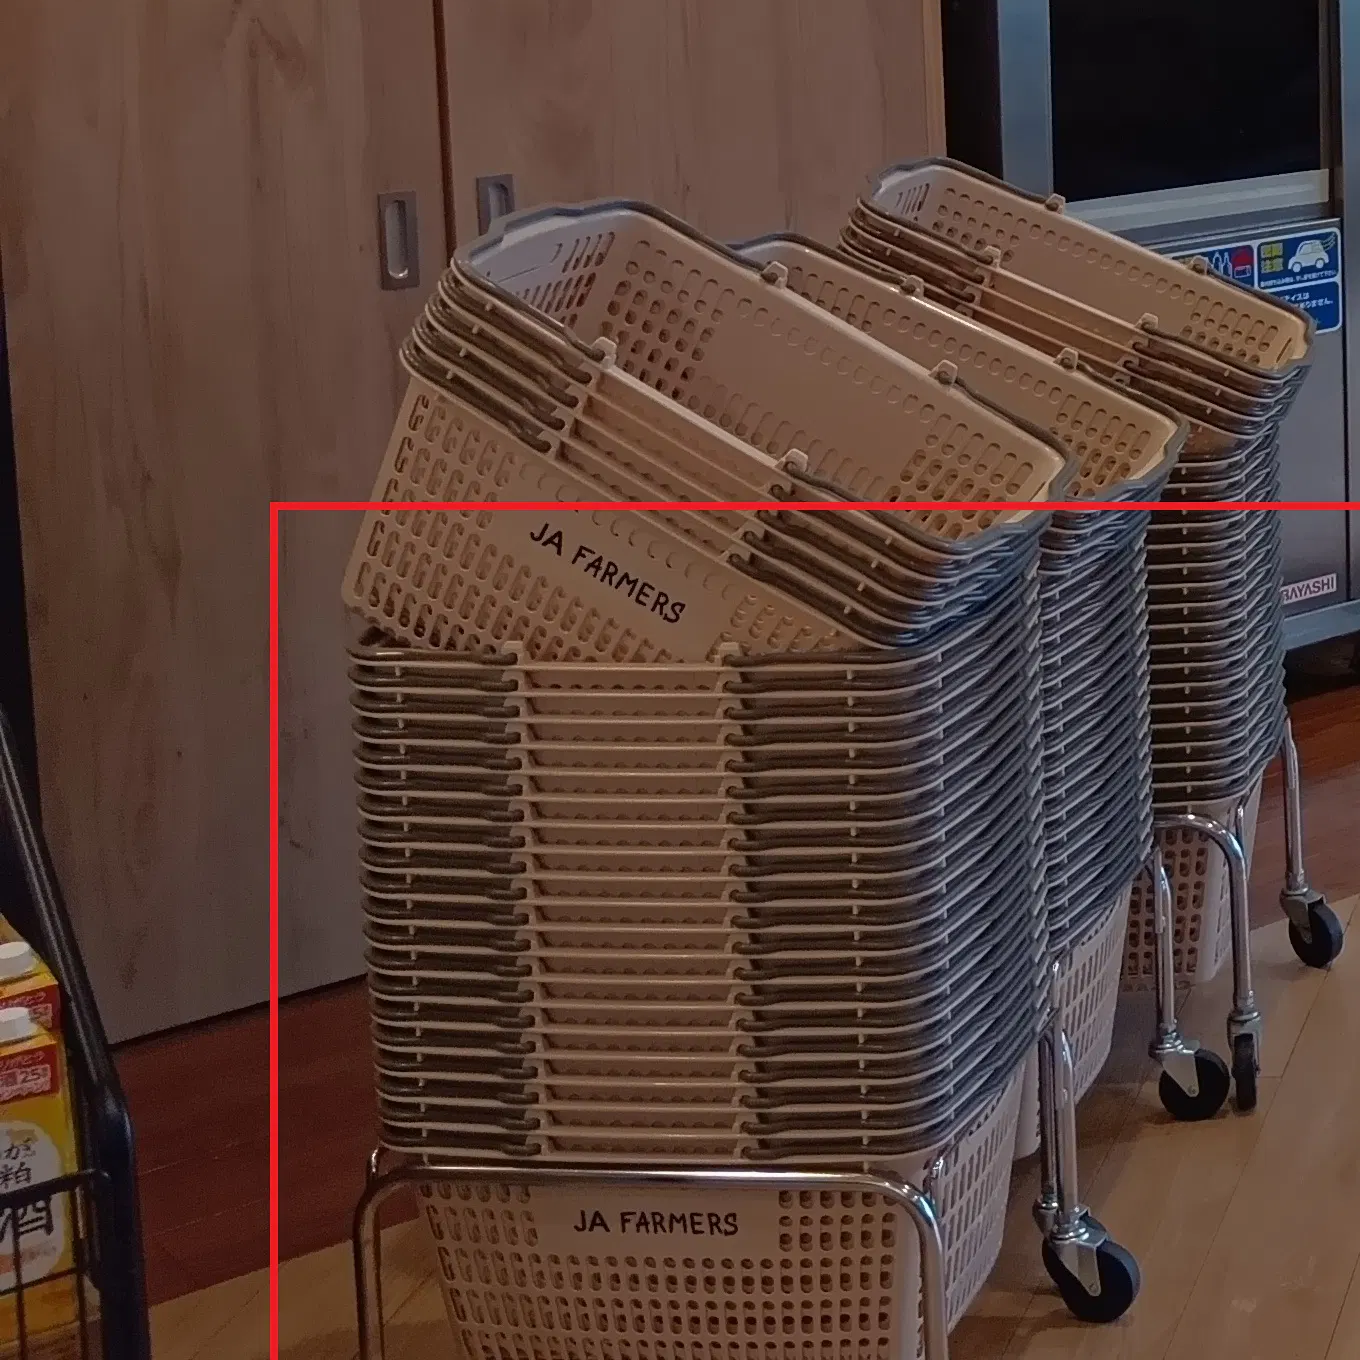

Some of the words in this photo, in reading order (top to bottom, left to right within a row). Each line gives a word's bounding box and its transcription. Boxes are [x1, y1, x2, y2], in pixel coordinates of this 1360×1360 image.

[529, 522, 563, 556] JA
[571, 545, 686, 623] FARMERS
[573, 1209, 610, 1233] JA
[620, 1211, 738, 1236] FARMERS
